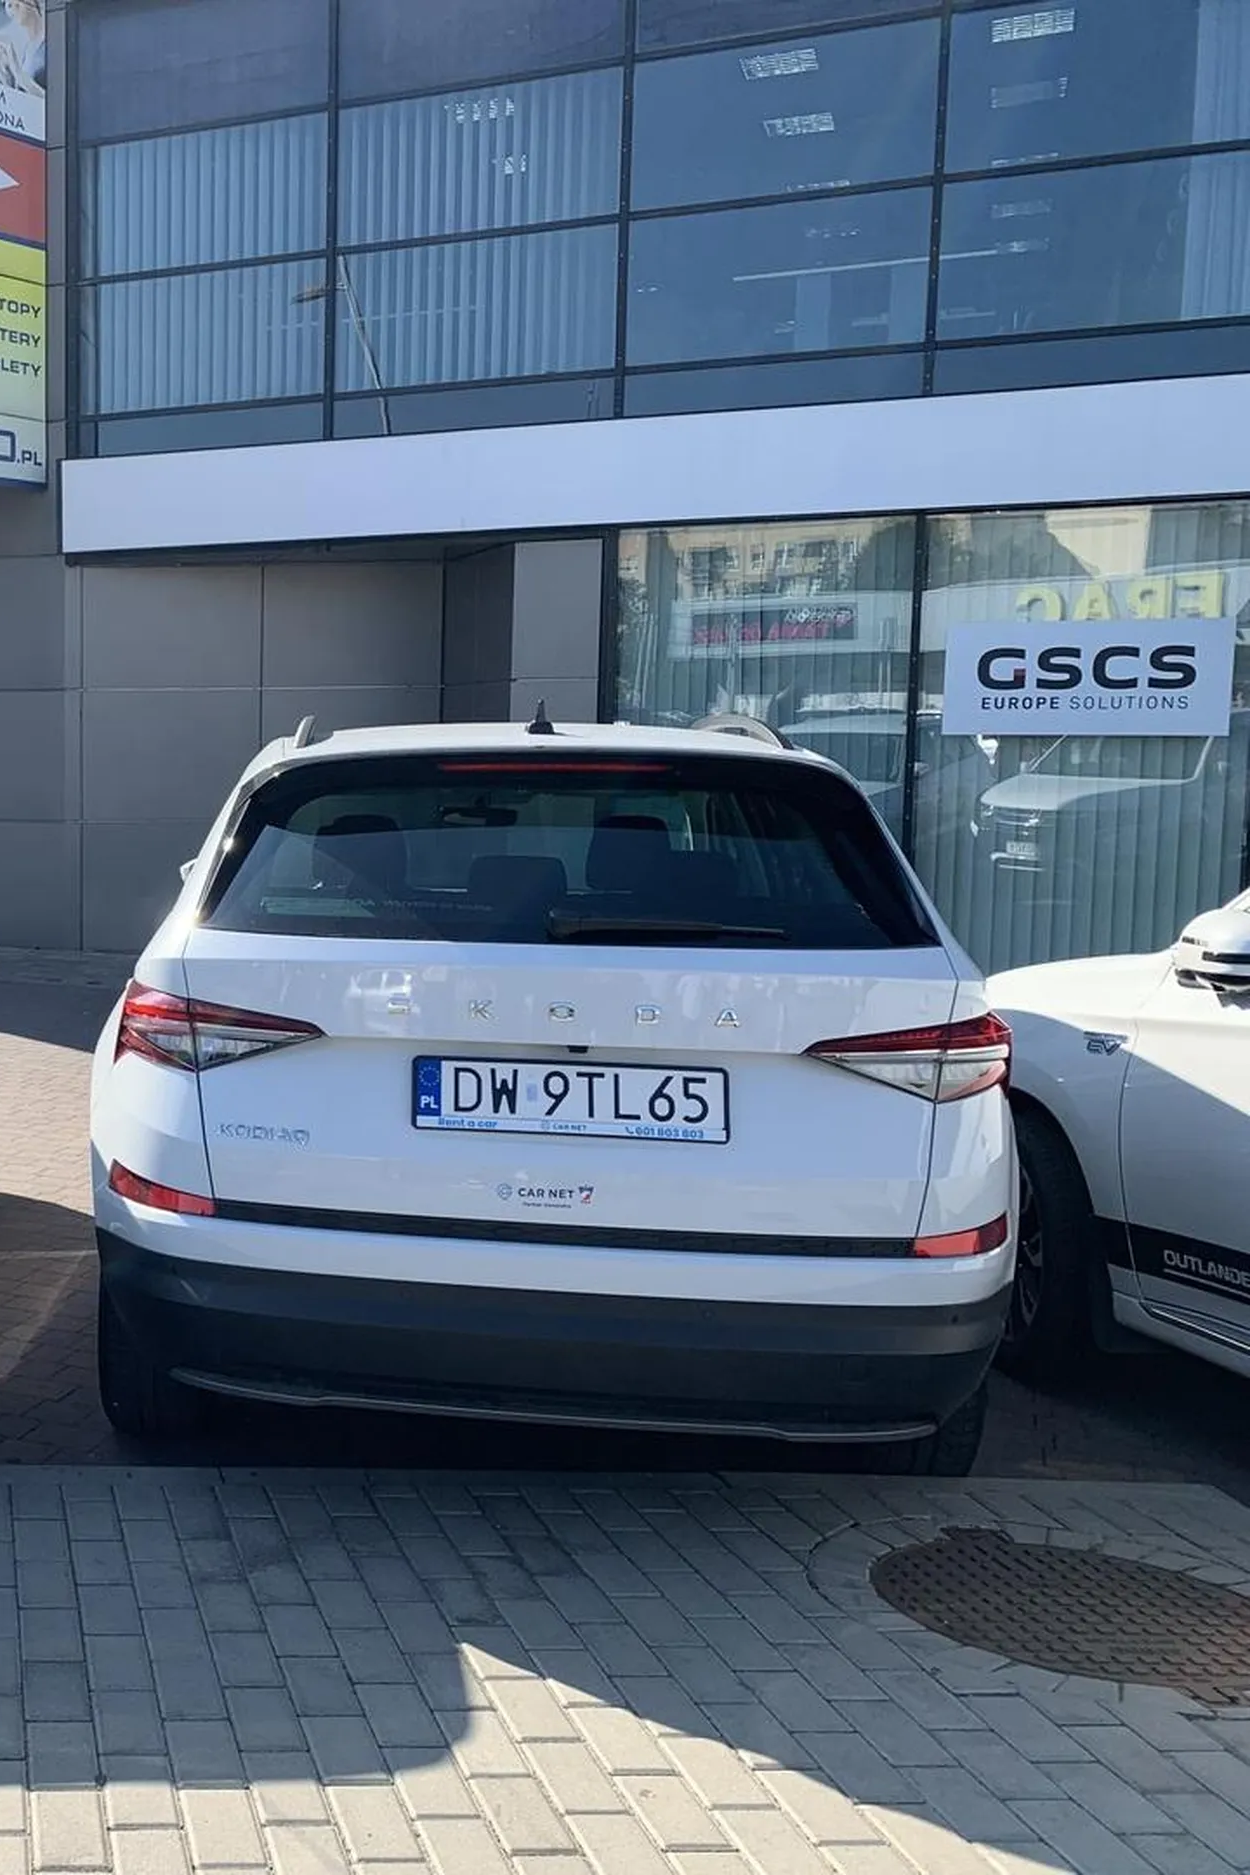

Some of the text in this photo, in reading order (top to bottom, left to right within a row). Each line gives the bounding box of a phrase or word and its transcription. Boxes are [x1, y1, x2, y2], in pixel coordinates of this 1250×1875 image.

[977, 645, 1197, 690] GSCS
[981, 695, 1189, 710] EUROPE SOLUTIONS
[419, 1095, 439, 1109] PL
[454, 1067, 709, 1123] DW 9TL65
[518, 1187, 575, 1199] CAR NET
